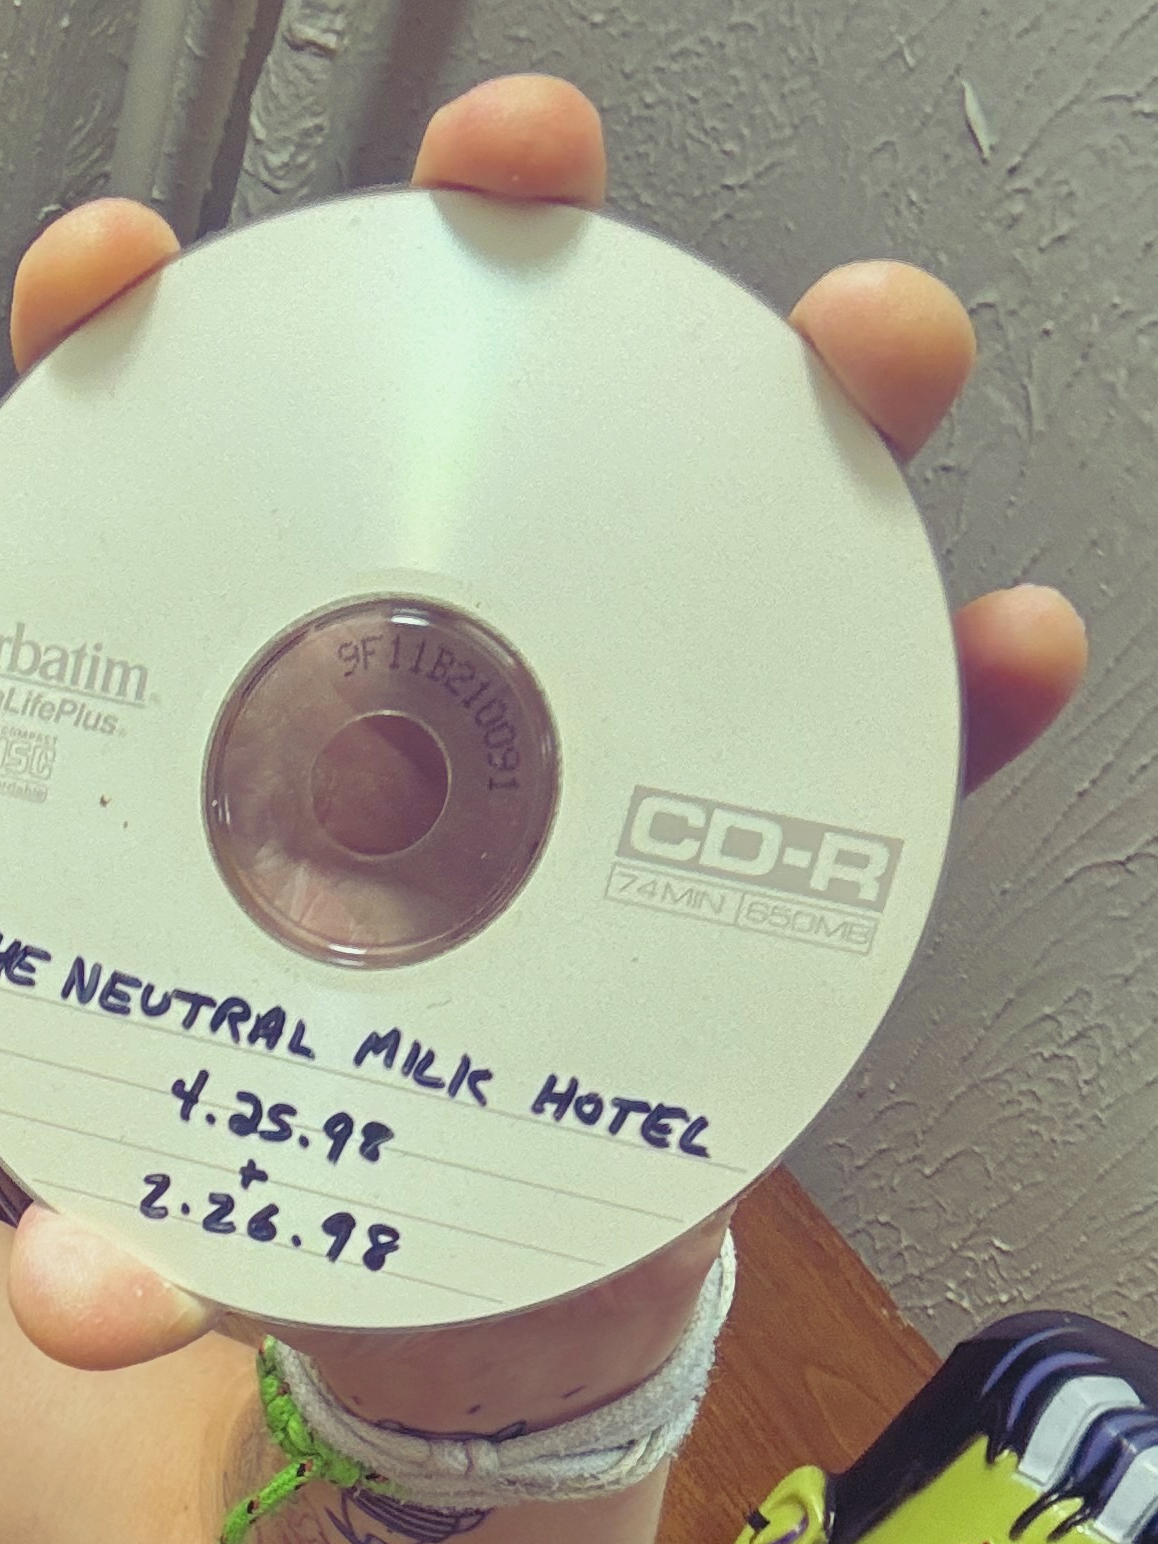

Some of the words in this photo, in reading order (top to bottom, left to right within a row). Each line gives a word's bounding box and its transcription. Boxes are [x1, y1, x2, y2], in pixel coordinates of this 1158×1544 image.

[630, 794, 890, 902] CD-R
[616, 870, 727, 914] 74MIN
[744, 900, 871, 945] 650MB
[60, 955, 316, 1060] NEUTRAL
[352, 1026, 494, 1107] MILK
[530, 1072, 711, 1159] HOTEL
[170, 1068, 395, 1165] 4.25.98
[140, 1172, 401, 1272] 2.26.98
